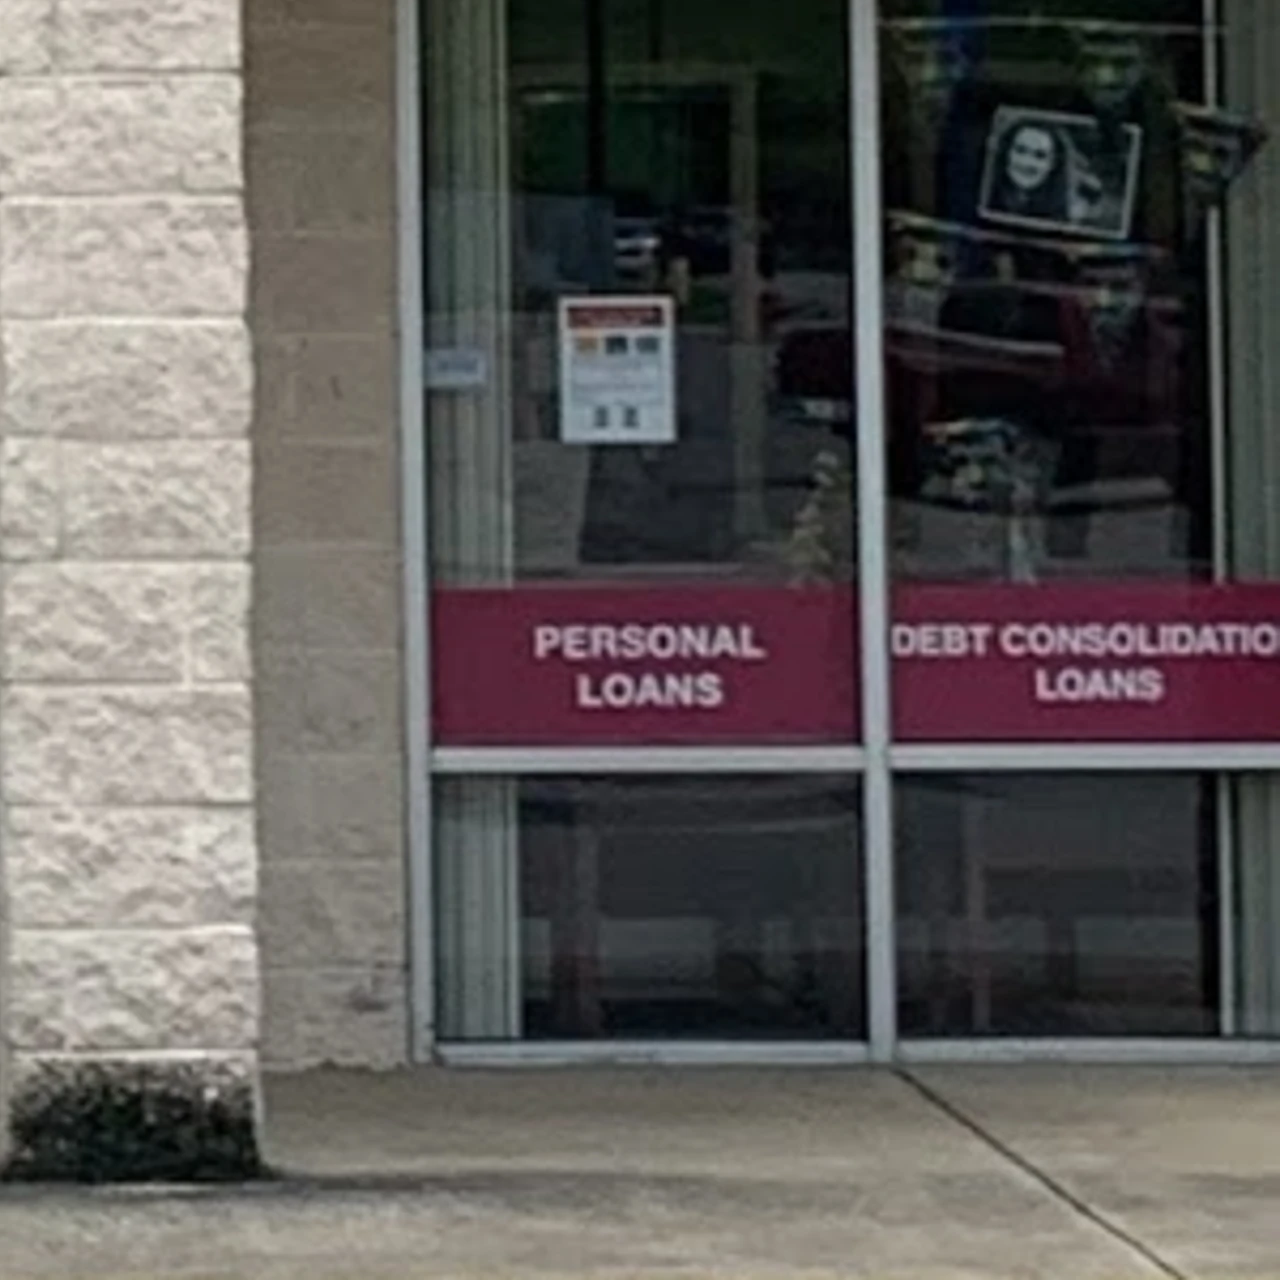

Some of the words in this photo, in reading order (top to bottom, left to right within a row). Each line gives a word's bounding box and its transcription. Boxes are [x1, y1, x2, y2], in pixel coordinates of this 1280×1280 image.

[534, 624, 768, 659] PERSONAL
[891, 624, 992, 656] DEBT
[576, 673, 725, 707] LOANS
[1035, 668, 1165, 701] LOANS
